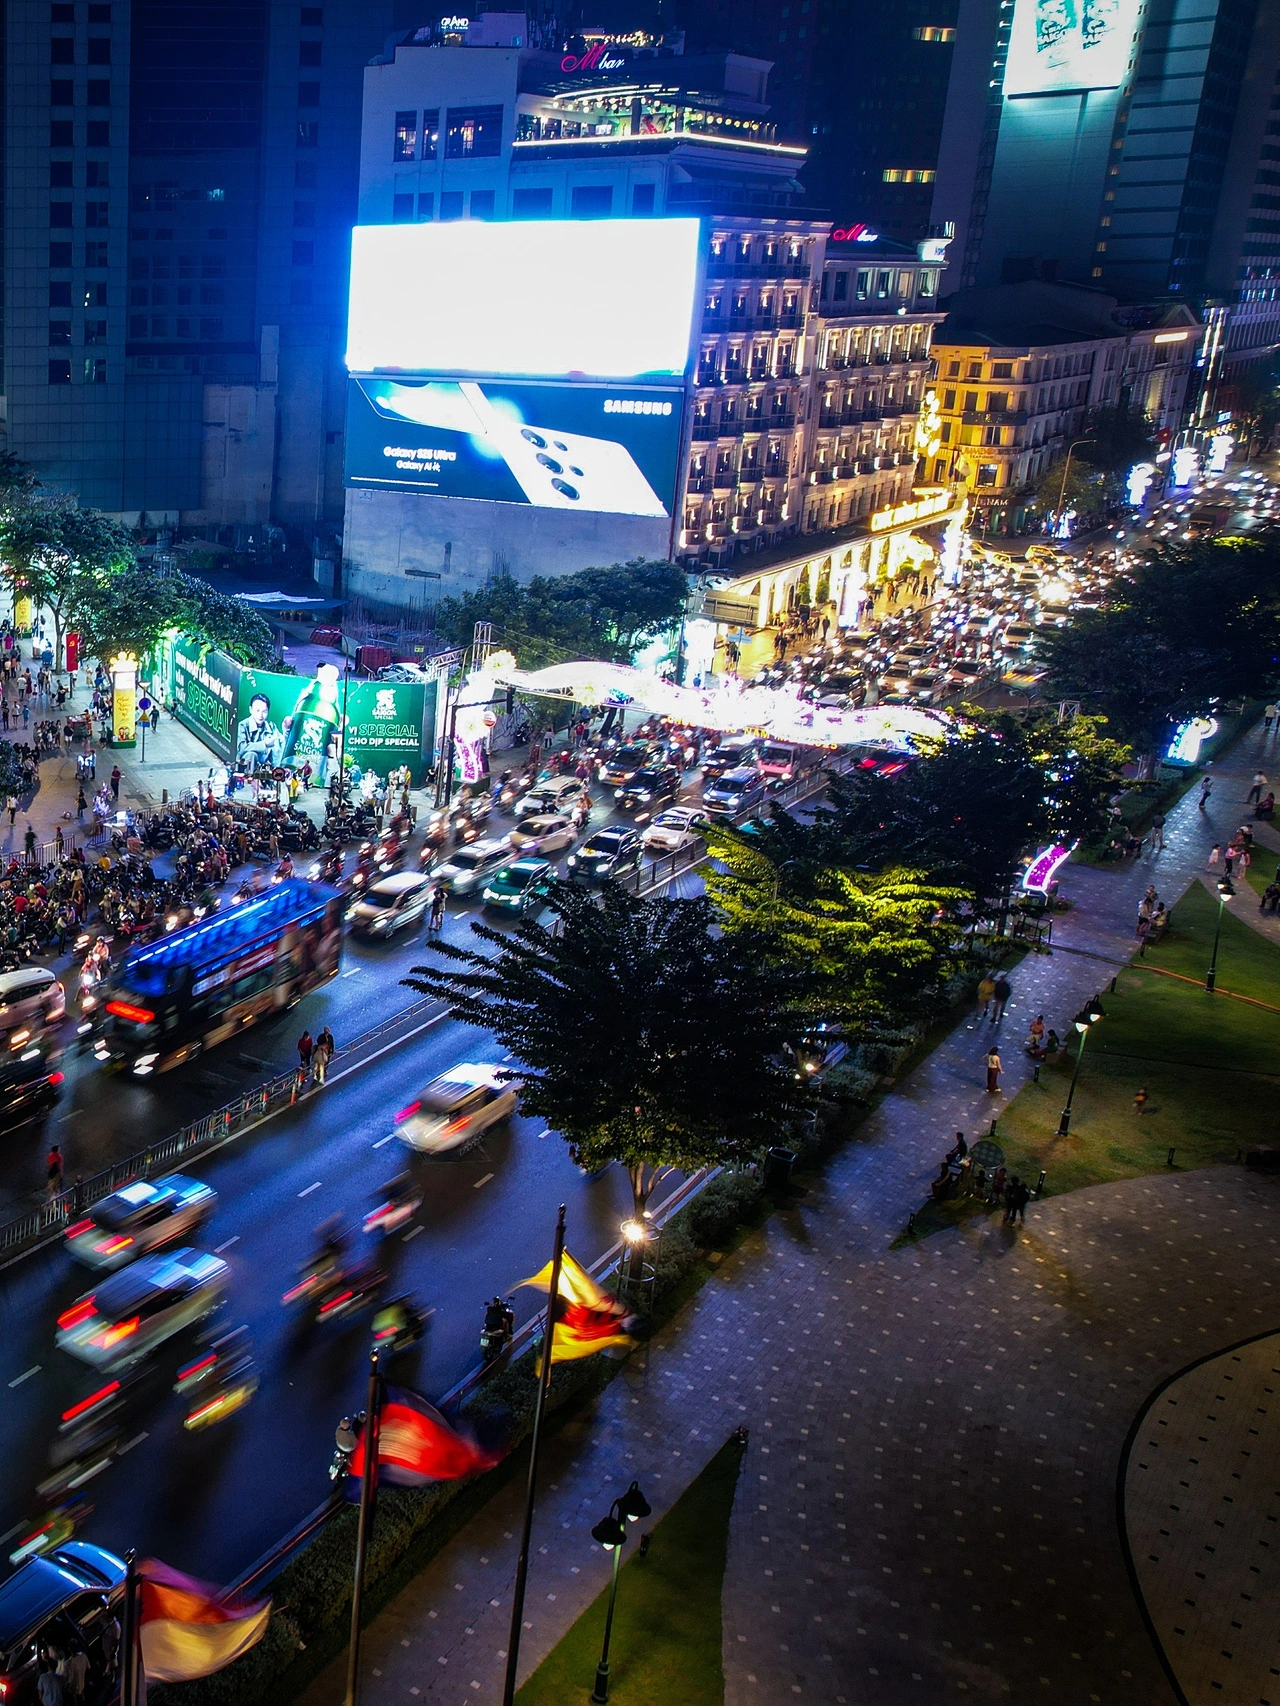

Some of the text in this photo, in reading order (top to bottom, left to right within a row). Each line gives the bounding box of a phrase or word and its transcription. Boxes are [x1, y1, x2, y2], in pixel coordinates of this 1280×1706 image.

[603, 399, 672, 416] SAMSUNG
[383, 446, 417, 460] Galaxy
[396, 460, 424, 472] Galaxy
[187, 680, 231, 743] SPECIAL
[359, 724, 419, 737] SPECIAL
[347, 737, 420, 747] CHO DỊP SPECIAL
